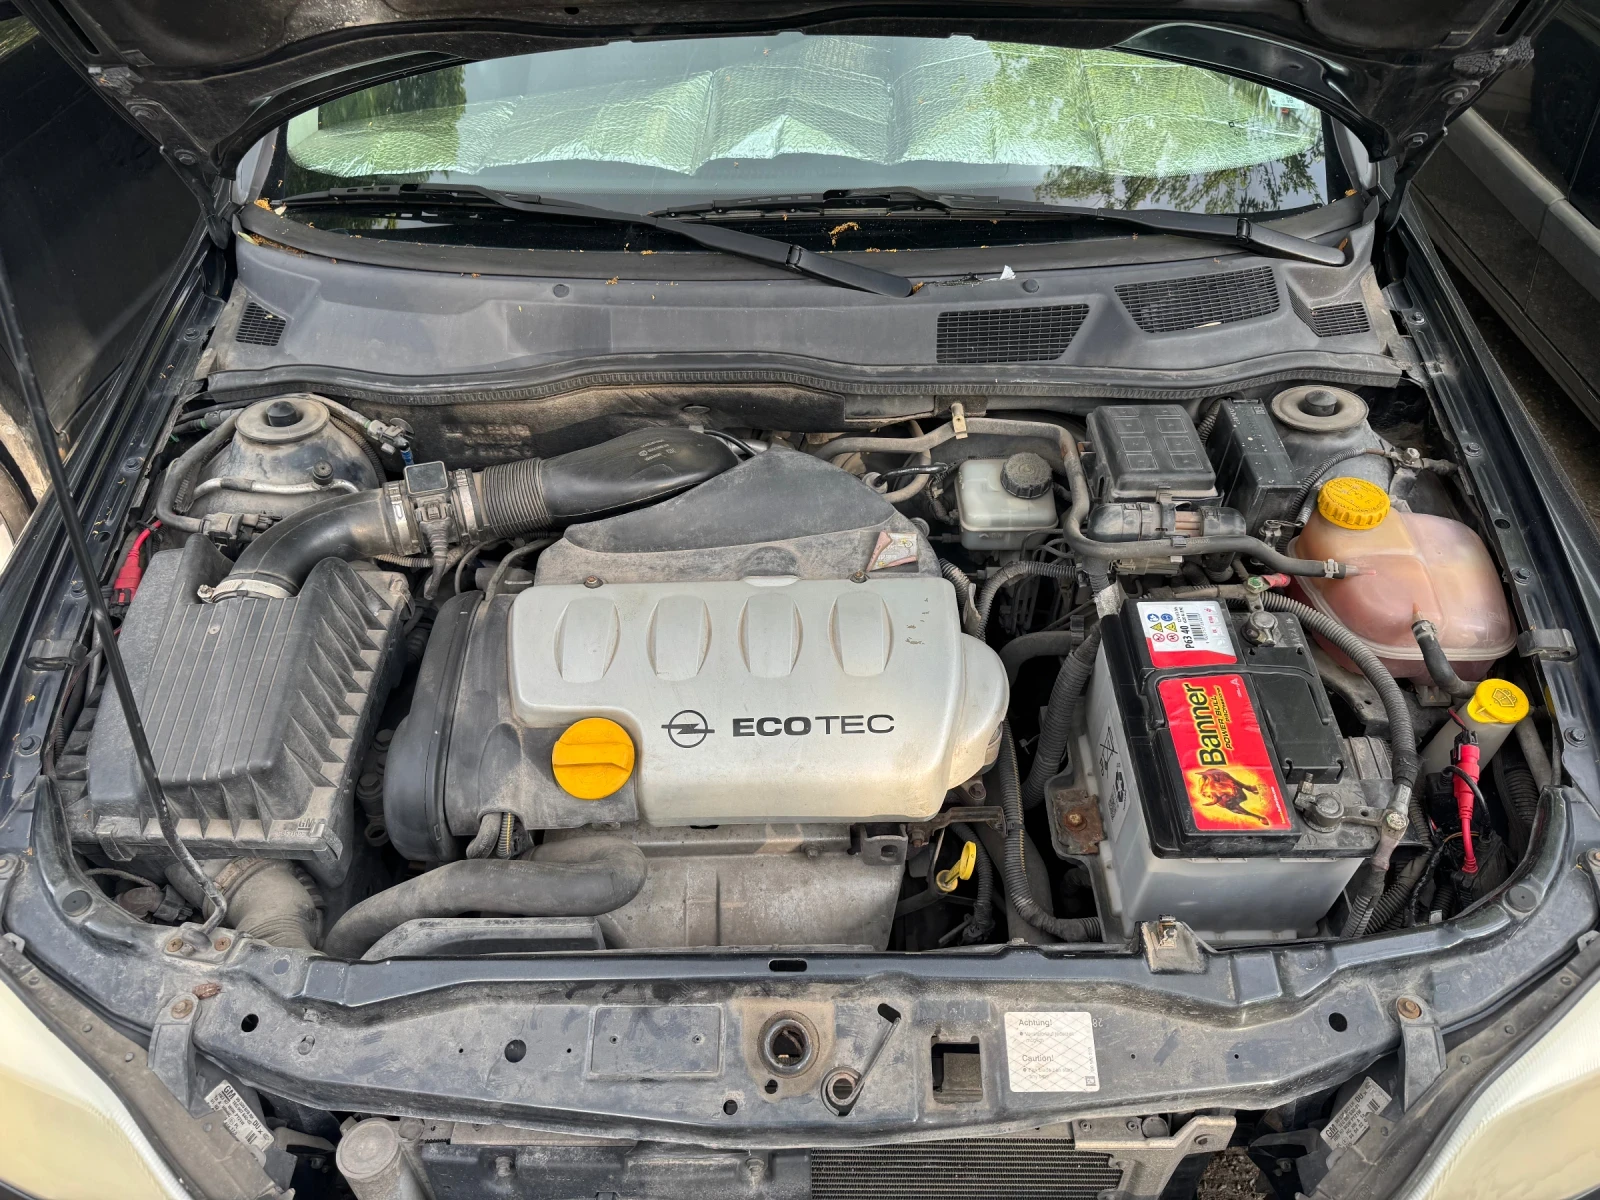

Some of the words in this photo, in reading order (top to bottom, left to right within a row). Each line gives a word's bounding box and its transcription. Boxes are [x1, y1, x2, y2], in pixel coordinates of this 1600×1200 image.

[1180, 625, 1189, 634] 40
[1182, 635, 1194, 648] P63
[1211, 696, 1221, 716] BULL
[733, 714, 895, 737] ECOTEC
[1184, 684, 1227, 765] Banner
[1218, 719, 1233, 749] POWER
[1019, 1019, 1053, 1027] Achtung!
[224, 1085, 236, 1099] GM
[1326, 1124, 1337, 1138] GM
[1355, 1093, 1364, 1102] DU
